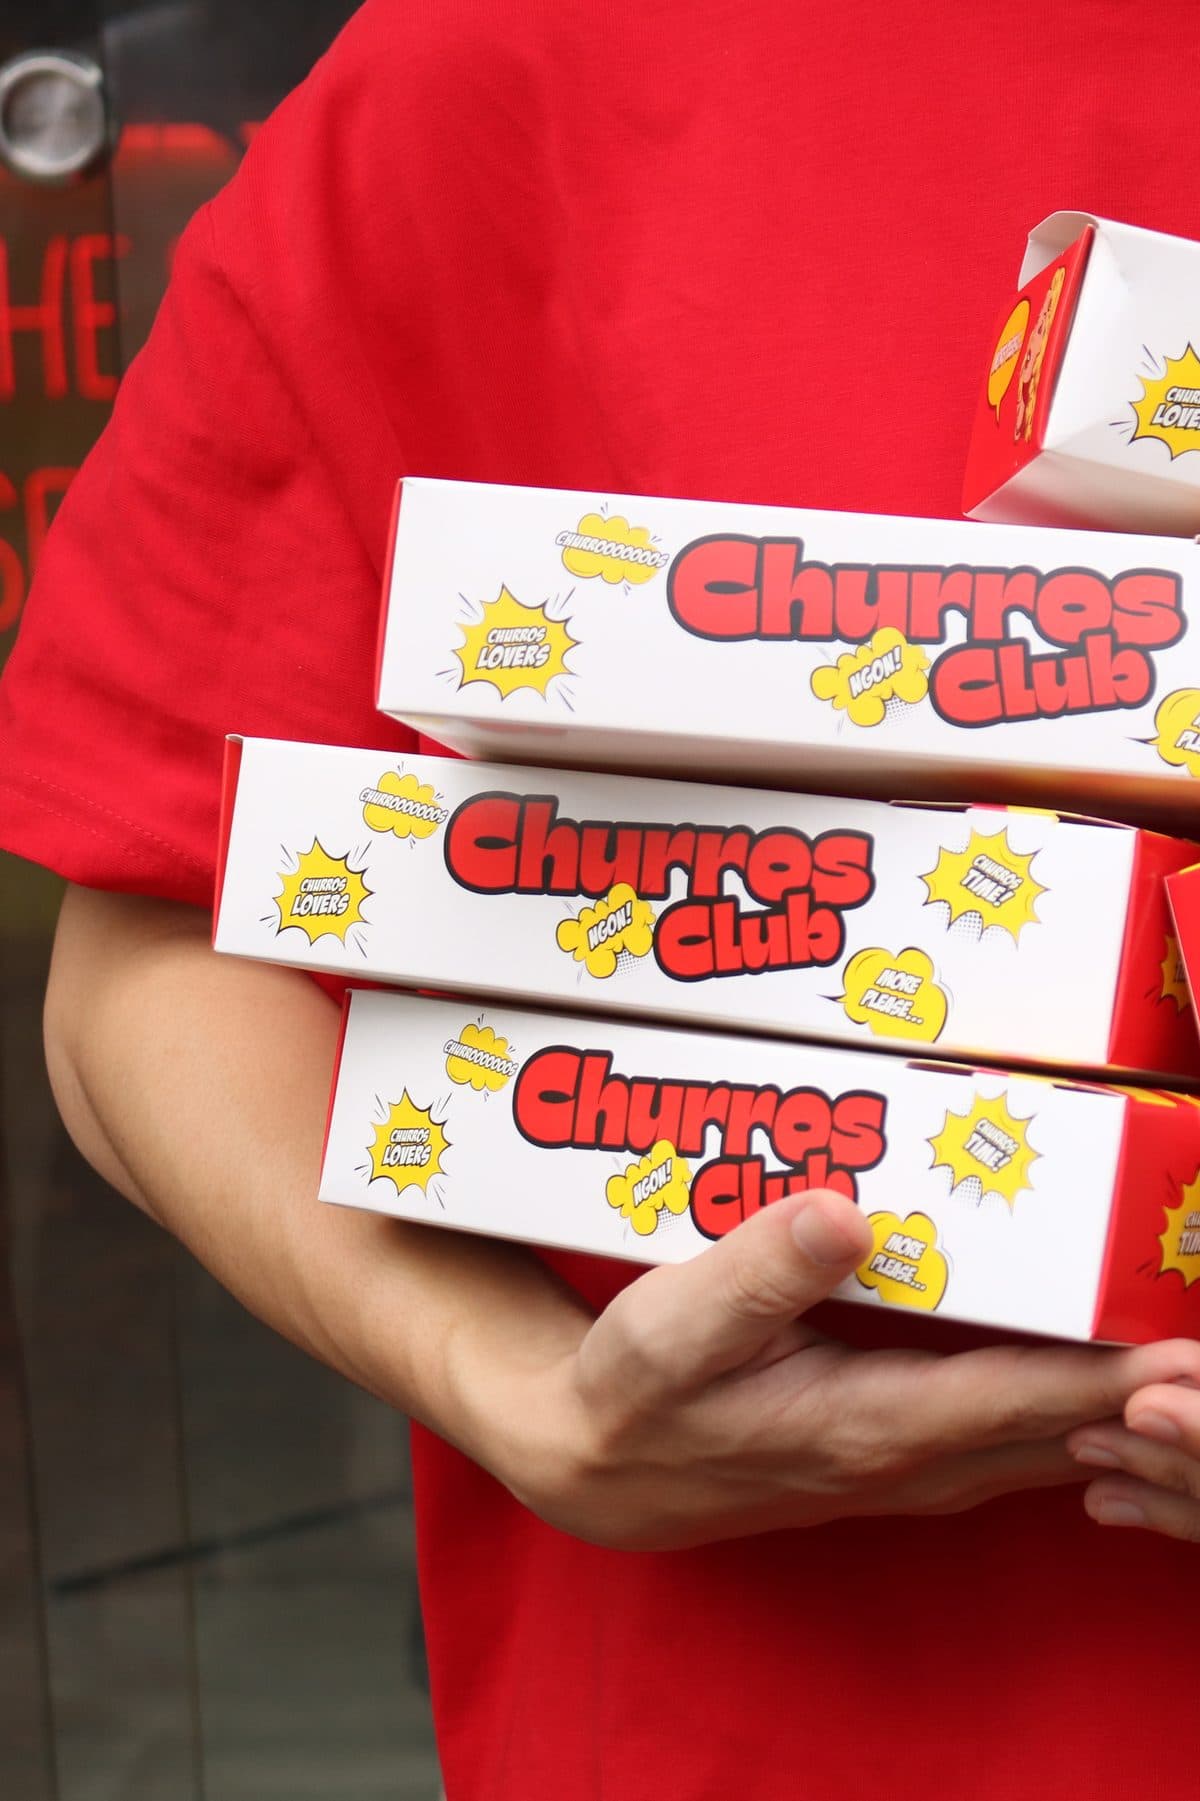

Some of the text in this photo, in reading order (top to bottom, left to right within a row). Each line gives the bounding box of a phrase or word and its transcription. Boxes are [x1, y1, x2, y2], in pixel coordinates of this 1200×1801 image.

[667, 533, 1187, 650] Churros
[487, 625, 546, 645] CHURROS
[475, 642, 551, 670] LOVERS
[849, 645, 903, 699] NGON!
[929, 629, 1156, 728] Club
[444, 791, 875, 910] Churros
[299, 876, 347, 894] CHURROS
[959, 867, 1014, 908] TIME!
[971, 852, 1024, 889] CHURROS
[291, 892, 350, 917] LOVERS
[588, 900, 632, 952] NGON!
[653, 888, 845, 982] Club
[876, 966, 921, 996] MORE
[859, 989, 925, 1025] PLEASE...
[512, 1044, 887, 1173] Churros
[382, 1143, 431, 1167] LOVERS
[390, 1127, 430, 1145] CHURROS
[962, 1132, 1012, 1174] TIME!
[974, 1117, 1020, 1156] CHURROS
[632, 1157, 674, 1208] NGON!
[884, 1231, 928, 1262] MORE
[868, 1254, 928, 1293] PLEASE...
